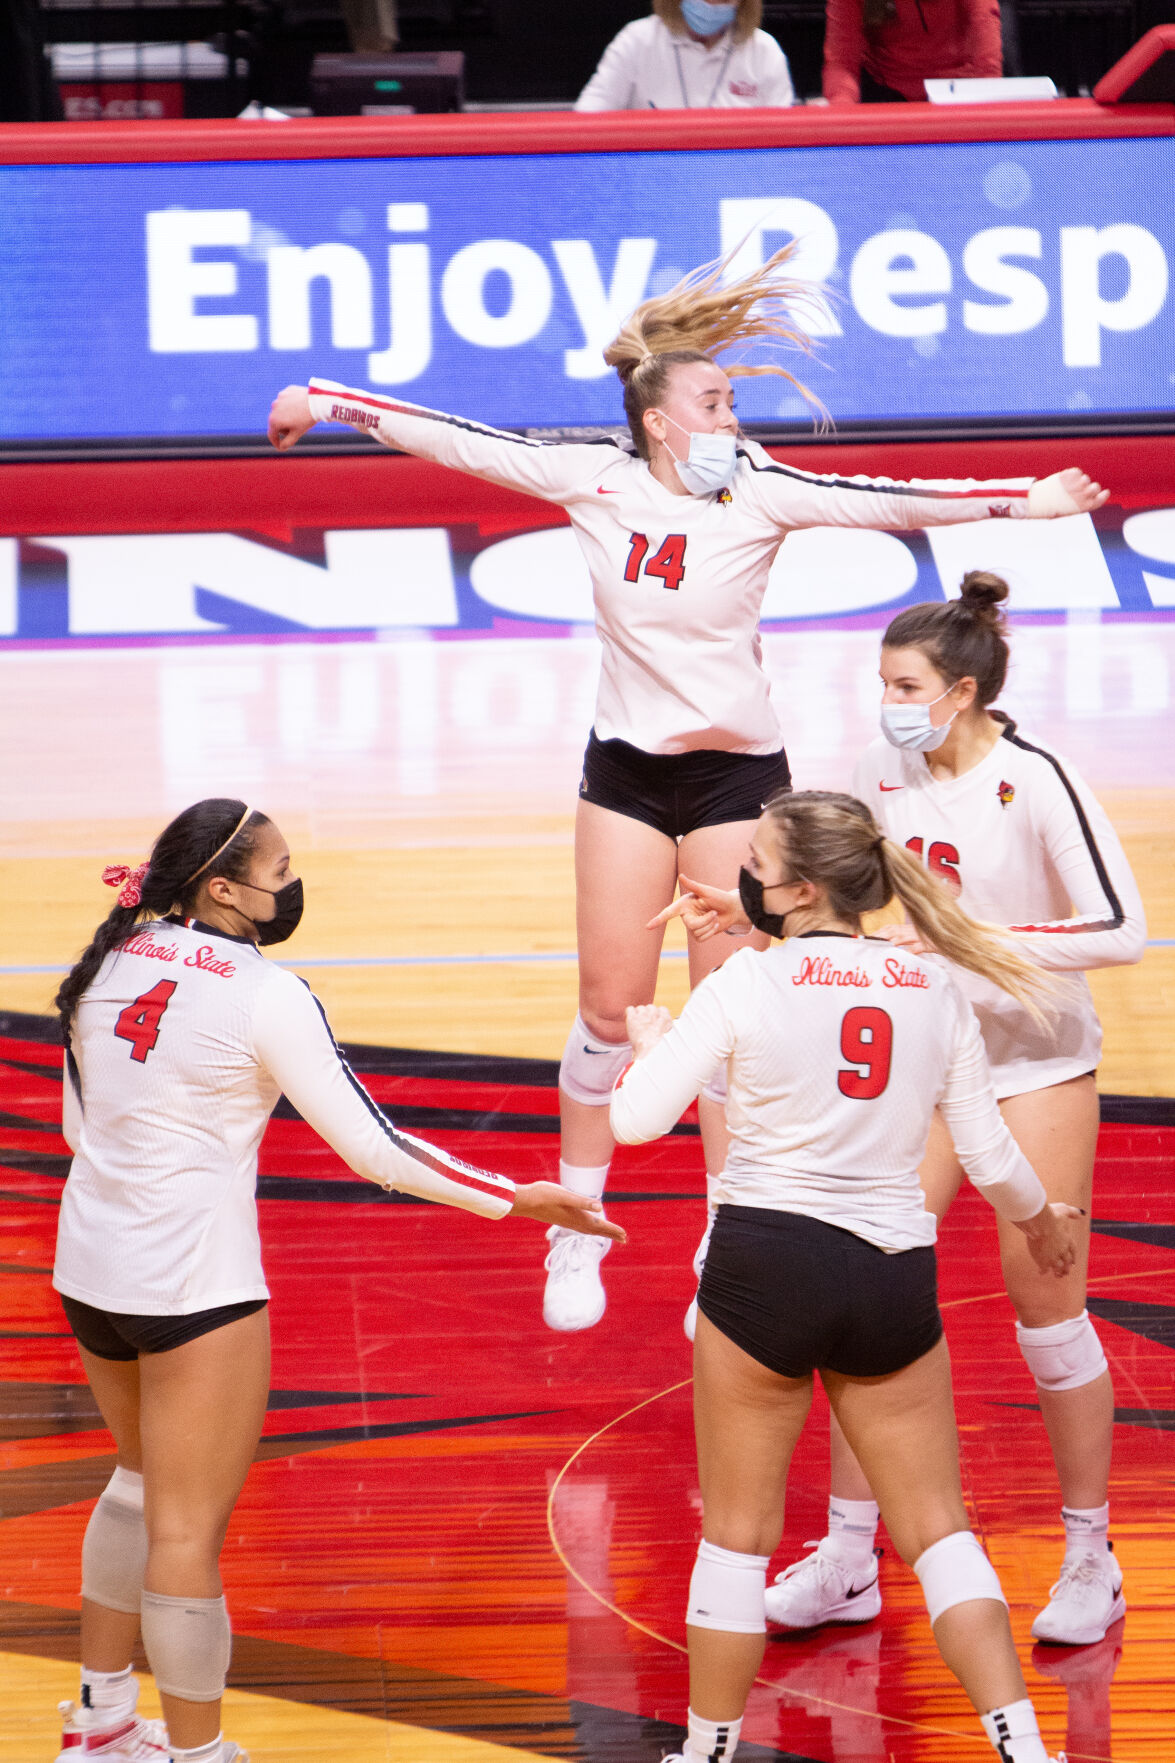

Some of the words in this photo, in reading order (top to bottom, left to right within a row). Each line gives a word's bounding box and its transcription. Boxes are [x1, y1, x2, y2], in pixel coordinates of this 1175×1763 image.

[146, 202, 657, 384] Enjoy
[719, 198, 1169, 368] Resp
[624, 532, 687, 590] 14
[183, 945, 237, 978] State
[791, 956, 873, 988] Illinois
[882, 958, 931, 989] State
[114, 979, 178, 1065] 4
[837, 1006, 894, 1100] 9
